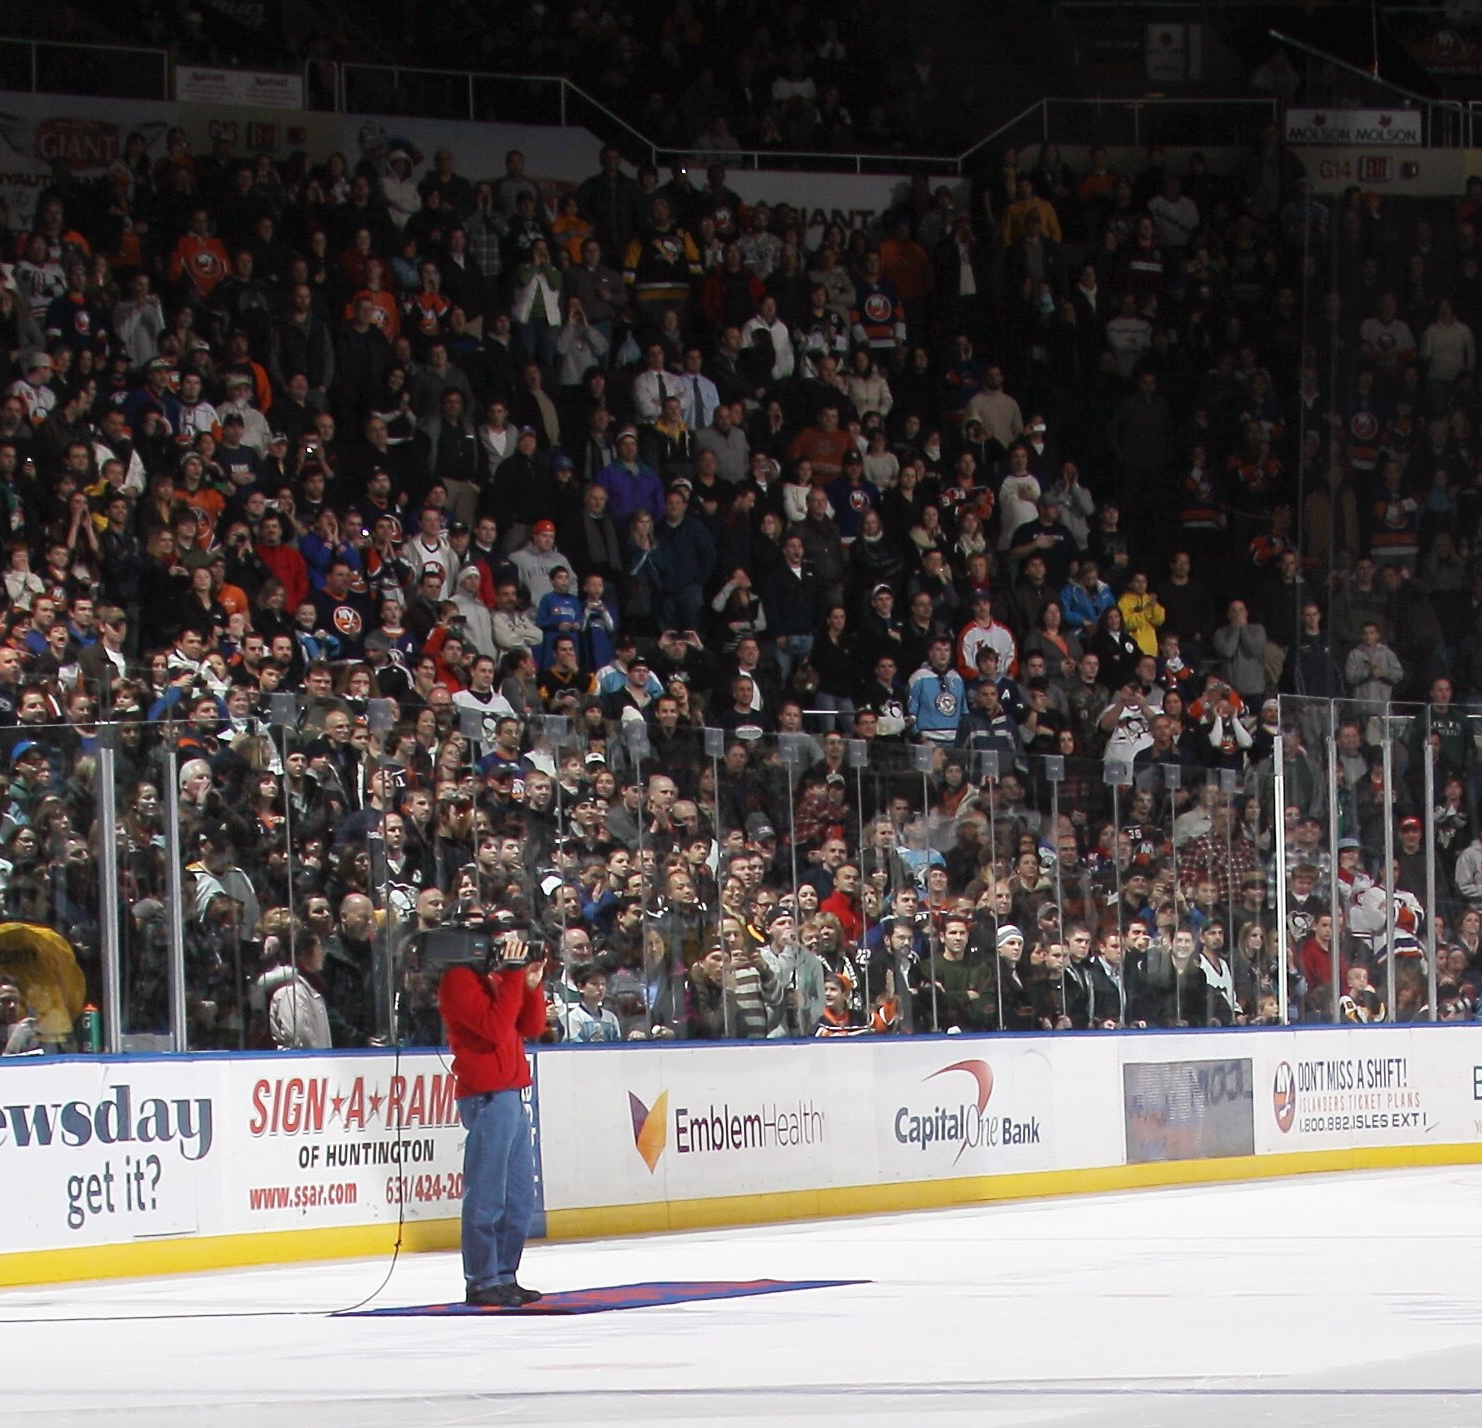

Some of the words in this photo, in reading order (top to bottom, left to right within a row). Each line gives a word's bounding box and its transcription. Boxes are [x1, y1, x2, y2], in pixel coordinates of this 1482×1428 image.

[1290, 127, 1350, 142] MOLSON
[1356, 128, 1416, 142] MOLSON
[1001, 688, 1011, 700] A
[1298, 1061, 1325, 1092] DON'T
[1327, 1060, 1353, 1091] MISS
[1357, 1060, 1364, 1090] A
[1367, 1057, 1407, 1089] SHIFT!
[1299, 1095, 1345, 1114] ISLANDERS
[1348, 1093, 1382, 1112] TICKET
[1387, 1092, 1421, 1109] PLANS
[1002, 1116, 1041, 1146] Bank
[1392, 1112, 1420, 1129] EXT
[298, 1145, 321, 1169] OF
[326, 1138, 435, 1166] HUNTINGTON
[67, 1160, 116, 1230] get
[125, 1154, 162, 1212] it?
[249, 1180, 358, 1211] www.ssar.com
[386, 1174, 464, 1204] 631/424-20
